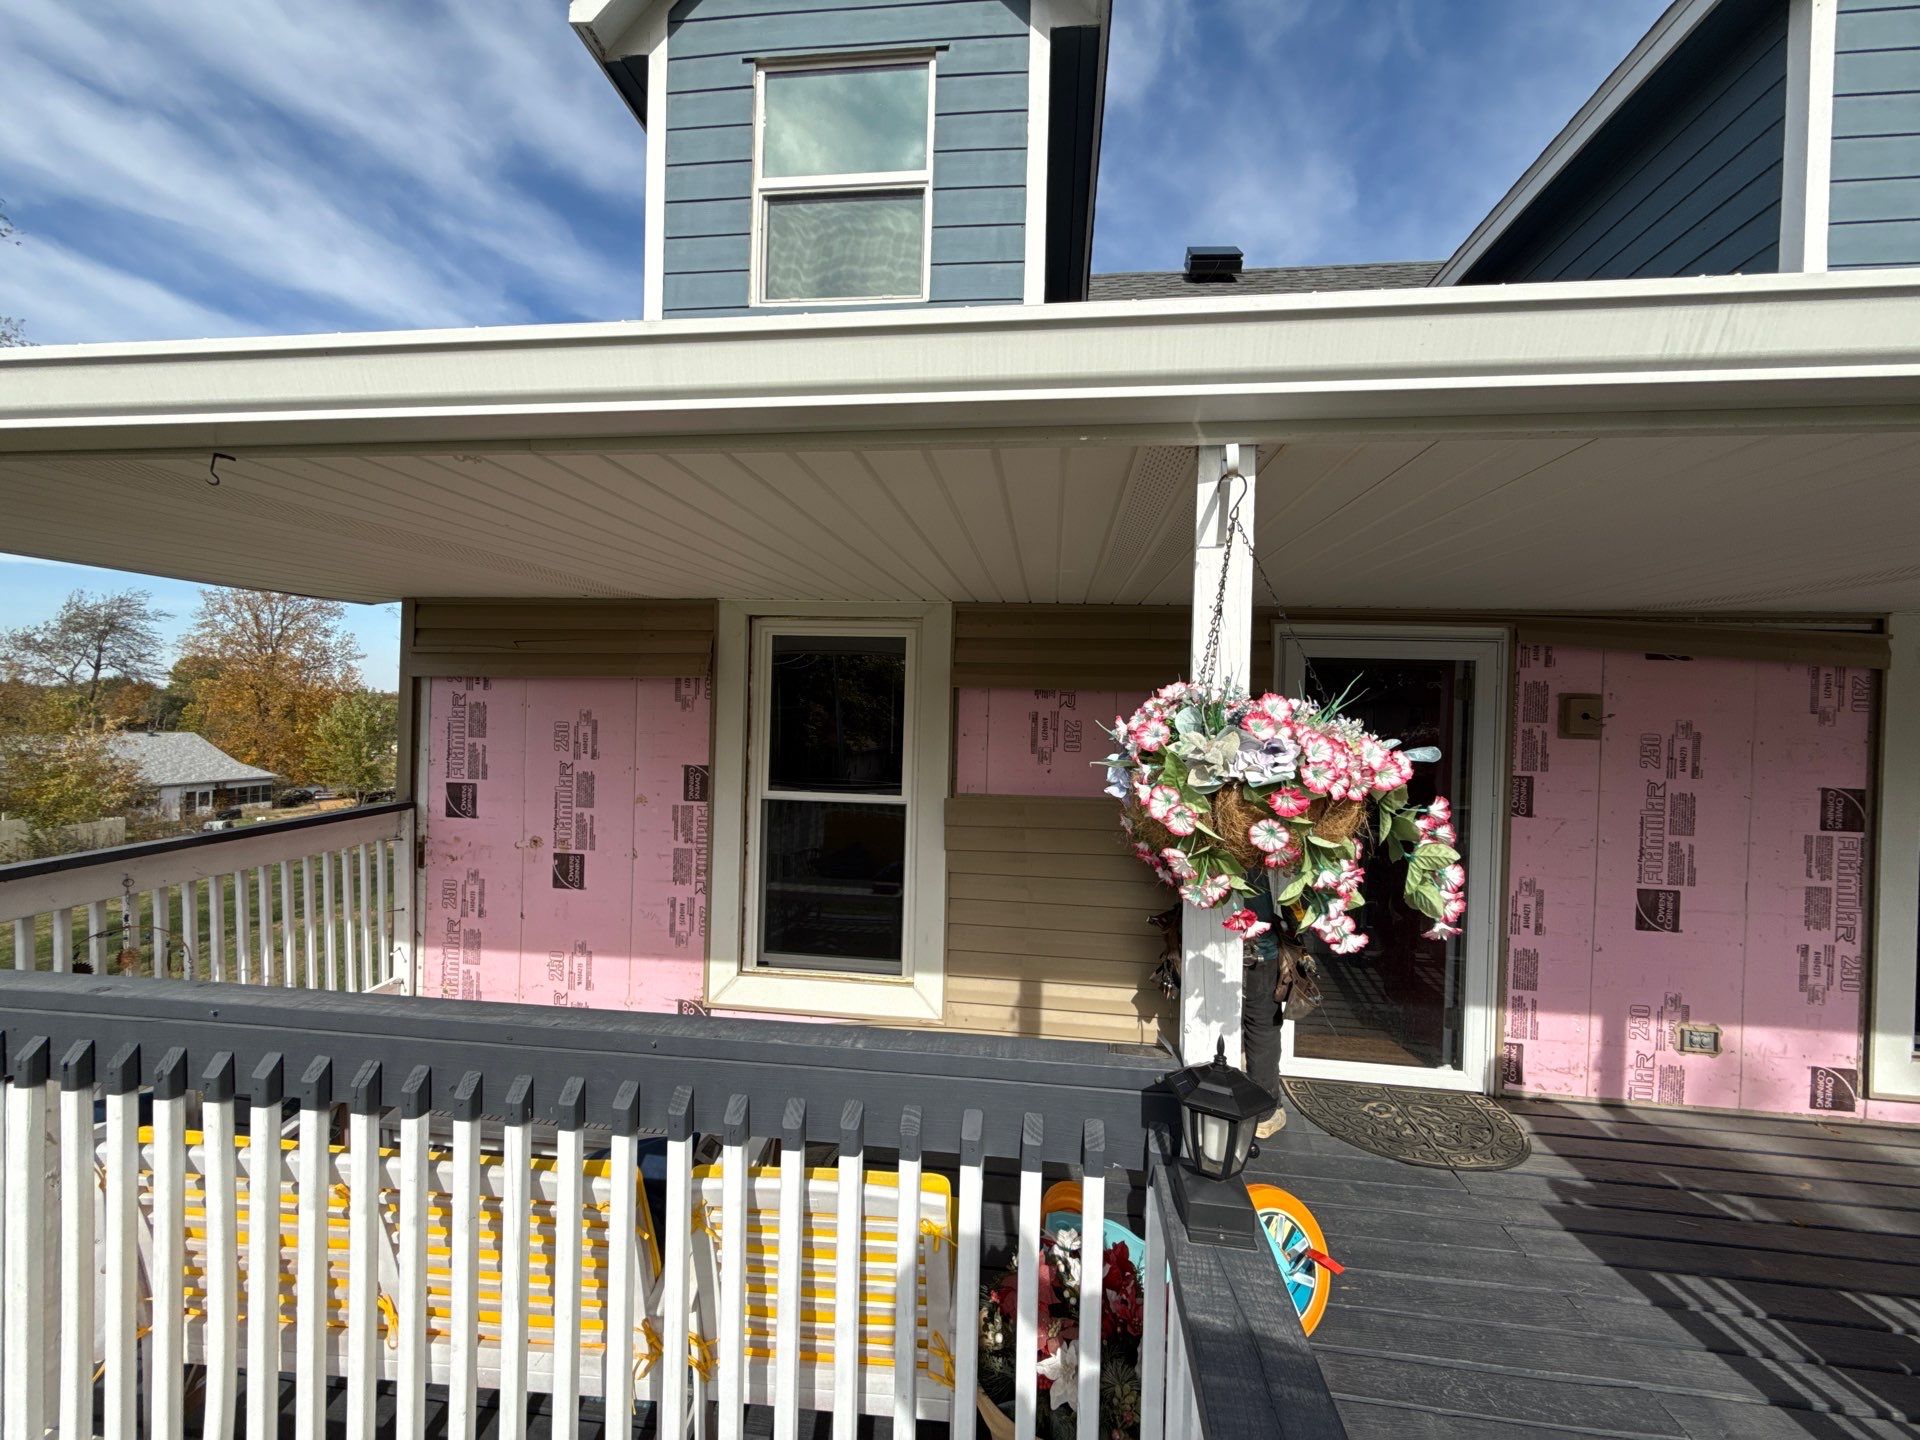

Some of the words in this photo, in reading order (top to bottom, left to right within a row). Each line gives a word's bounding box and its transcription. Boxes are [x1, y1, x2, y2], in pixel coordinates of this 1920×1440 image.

[1851, 676, 1870, 712] 250
[554, 721, 569, 751] 250
[1064, 720, 1082, 752] 250
[1639, 734, 1660, 768] 250
[1511, 777, 1519, 808] OWENS
[1519, 778, 1527, 815] CORNING
[1827, 791, 1836, 828] CORNING
[1835, 797, 1844, 828] OWENS
[442, 879, 457, 909] 250
[1657, 892, 1666, 923] OWENS
[1665, 892, 1674, 929] CORNING
[549, 952, 564, 981] 250
[1840, 955, 1865, 992] 250
[1628, 1004, 1650, 1040] 250
[1508, 1045, 1517, 1082] CORNING
[1816, 1070, 1826, 1107] CORNING
[1825, 1077, 1834, 1107] OWENS
